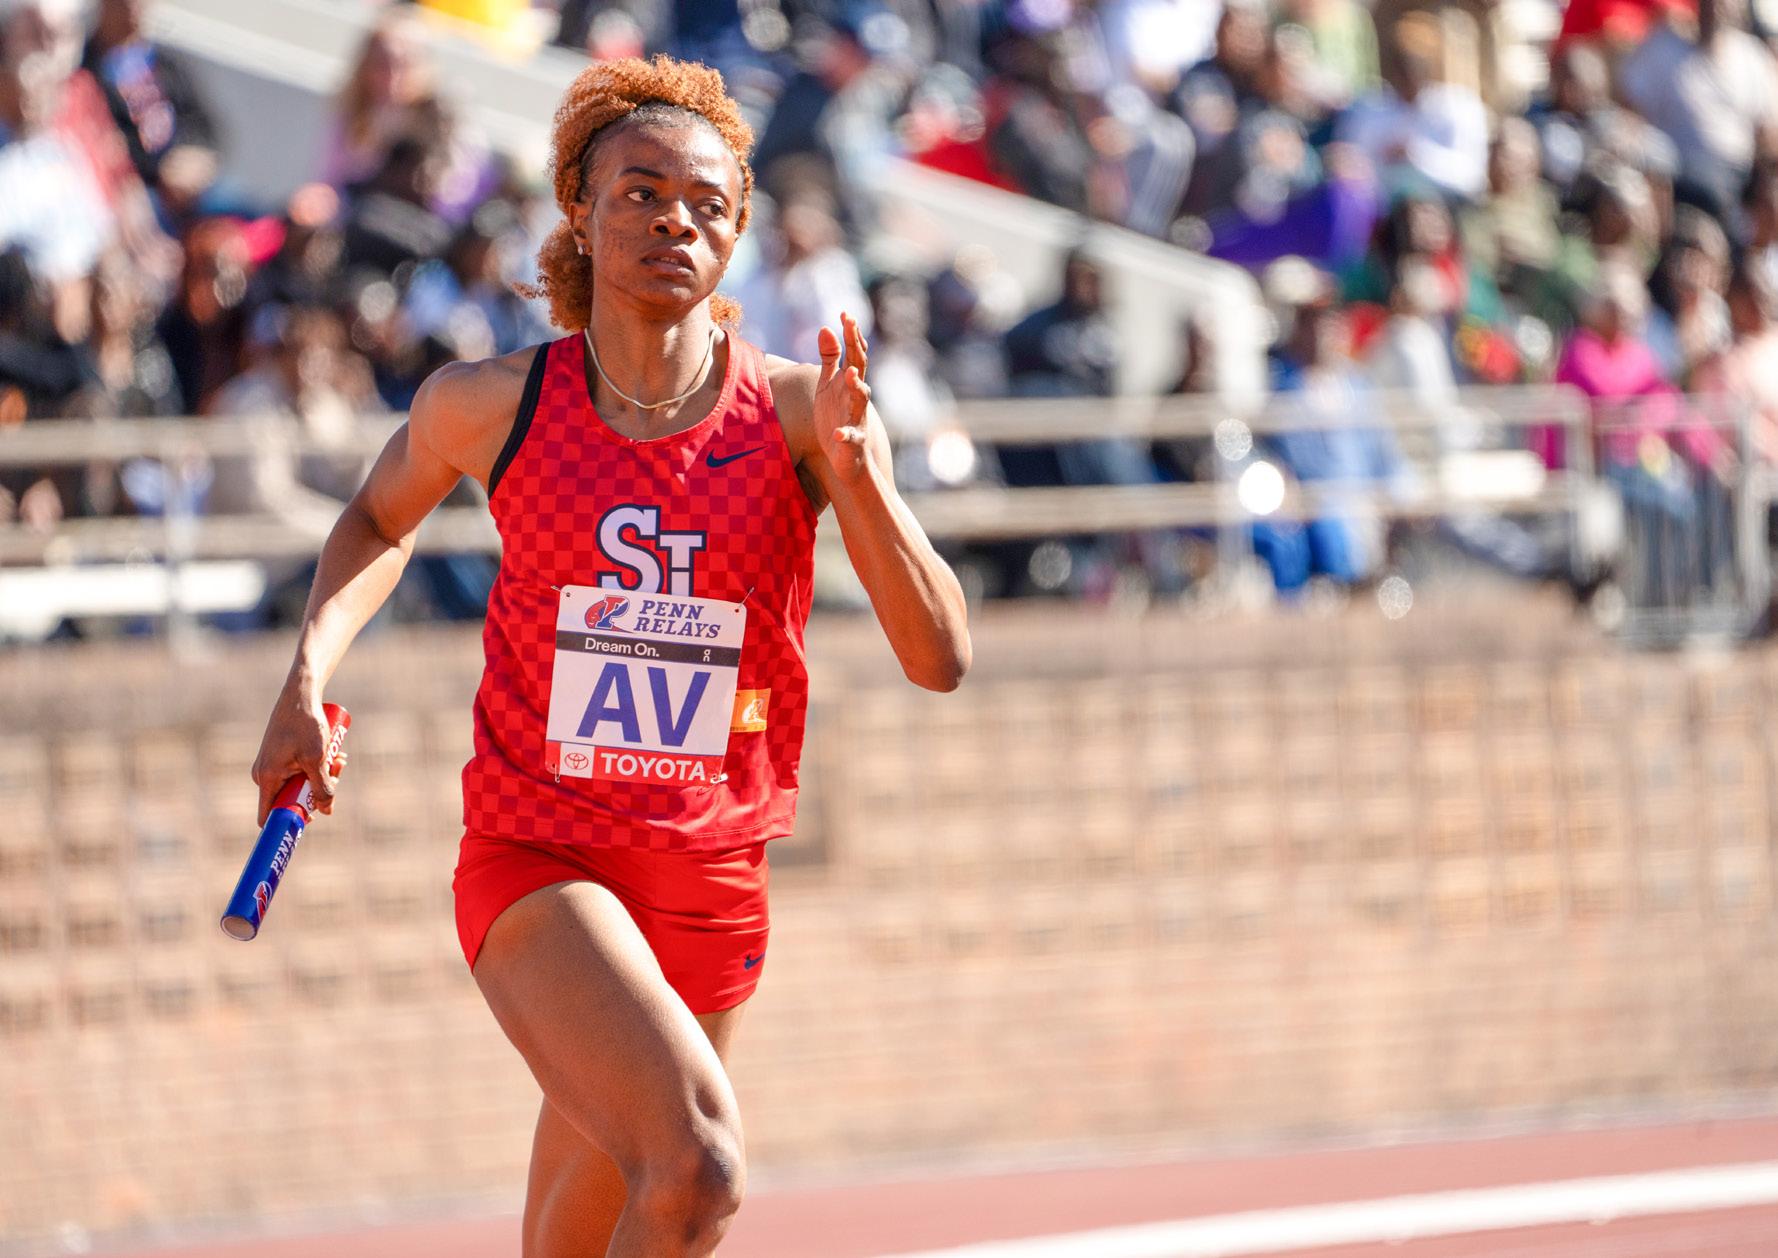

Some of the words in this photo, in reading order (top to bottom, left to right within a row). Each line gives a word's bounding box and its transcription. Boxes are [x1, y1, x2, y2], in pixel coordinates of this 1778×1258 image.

[639, 600, 704, 620] PENN
[633, 617, 721, 638] RELAYS
[584, 637, 632, 654] Dream
[634, 643, 660, 657] On.
[576, 662, 711, 747] AV
[600, 753, 706, 781] TOYOTA
[270, 830, 295, 876] PENN
